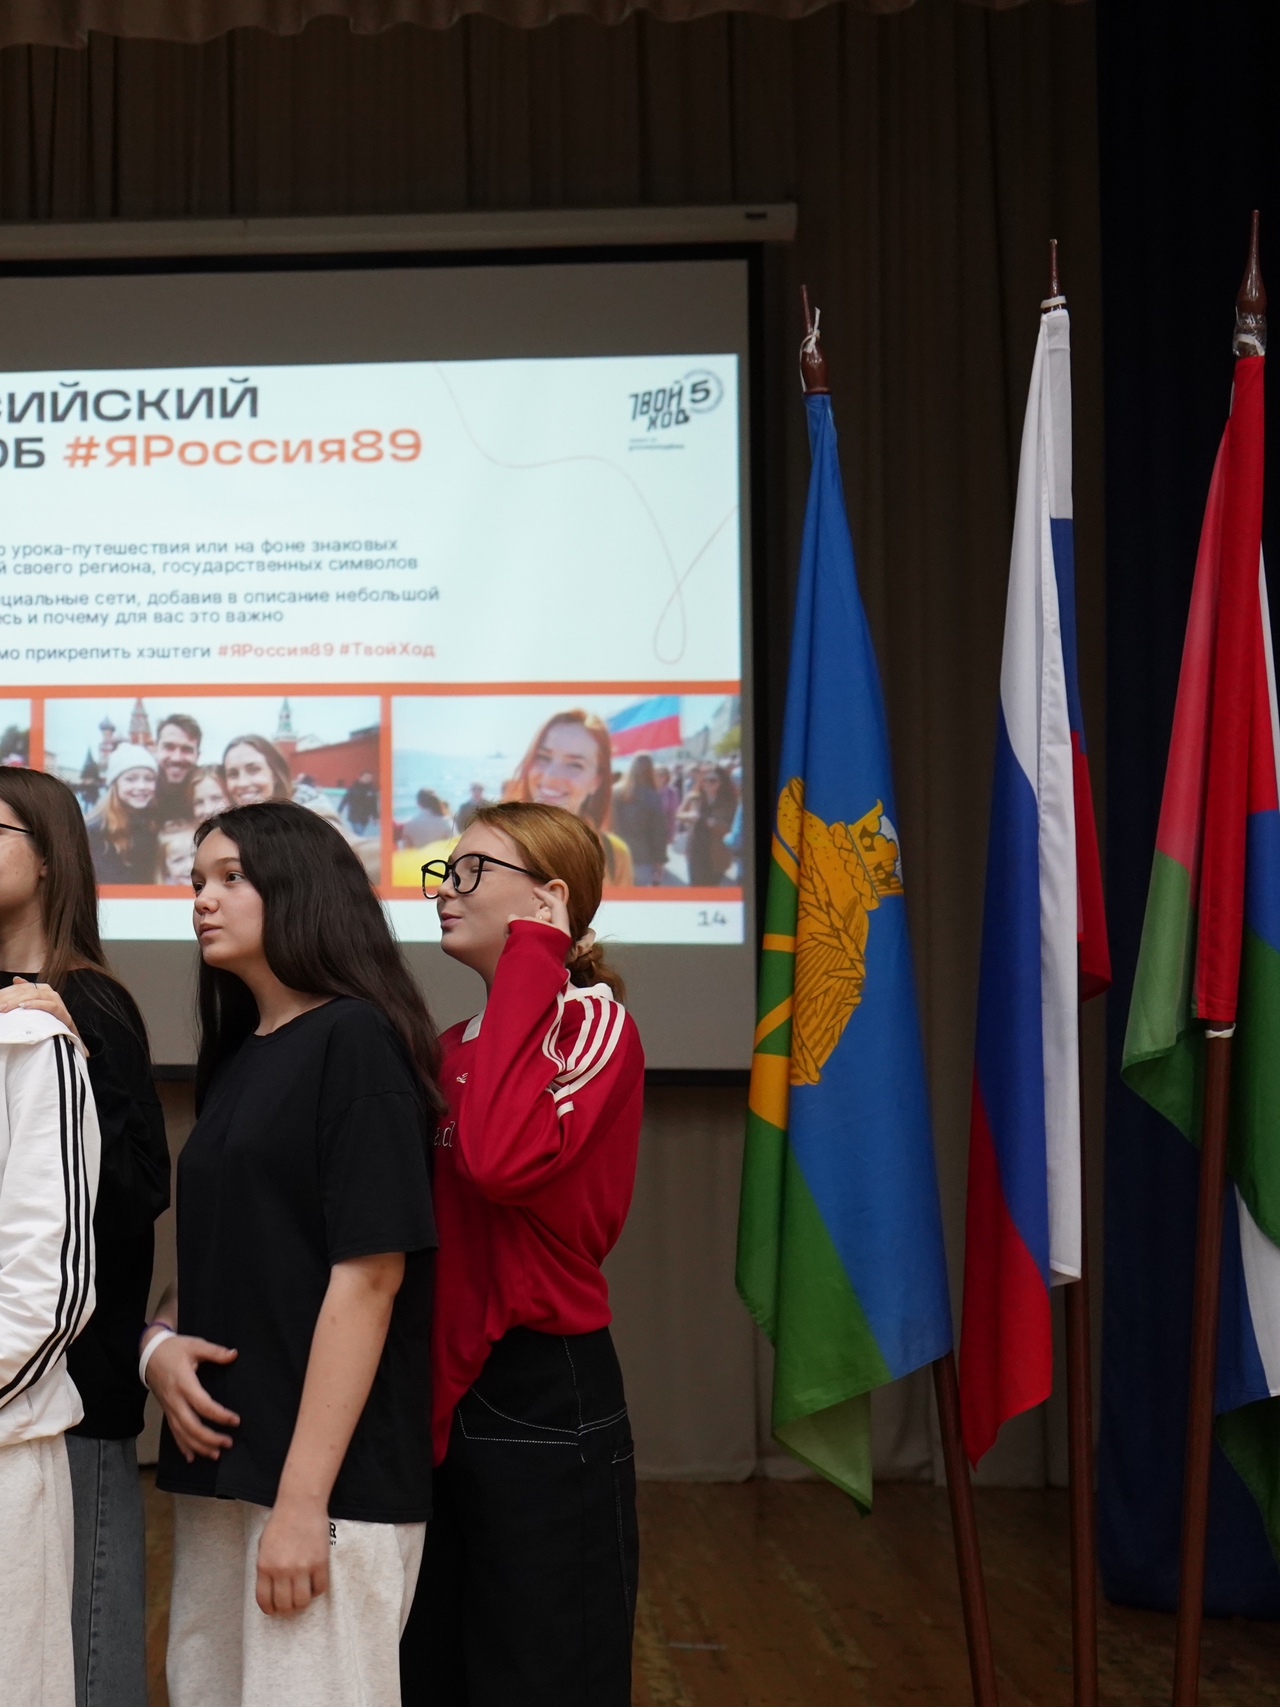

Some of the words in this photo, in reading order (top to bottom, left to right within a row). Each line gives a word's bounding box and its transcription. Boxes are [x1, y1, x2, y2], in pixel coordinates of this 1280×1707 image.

[690, 379, 711, 404] 5
[62, 428, 422, 468] #ЯРоссия89
[11, 540, 190, 558] урока-путешествия
[195, 541, 228, 553] или
[235, 541, 255, 553] на
[260, 538, 305, 554] фоне
[311, 538, 398, 552] знаковых
[13, 563, 73, 576] своего
[79, 561, 156, 576] региона,
[162, 559, 322, 574] государственных
[328, 557, 418, 571] символов
[95, 592, 141, 607] сети,
[147, 590, 222, 606] добавив
[228, 592, 237, 603] в
[244, 589, 331, 604] описание
[336, 586, 440, 602] небольшой
[28, 612, 38, 623] и
[43, 611, 109, 626] почему
[115, 609, 147, 625] для
[154, 610, 184, 622] вас
[190, 610, 220, 622] это
[226, 609, 283, 622] важно
[25, 645, 131, 662] прикрепить
[137, 646, 211, 658] хэштеги
[218, 643, 334, 657] #ЯРоссия89
[340, 641, 436, 657] #ТвойХод
[697, 911, 726, 927] 14
